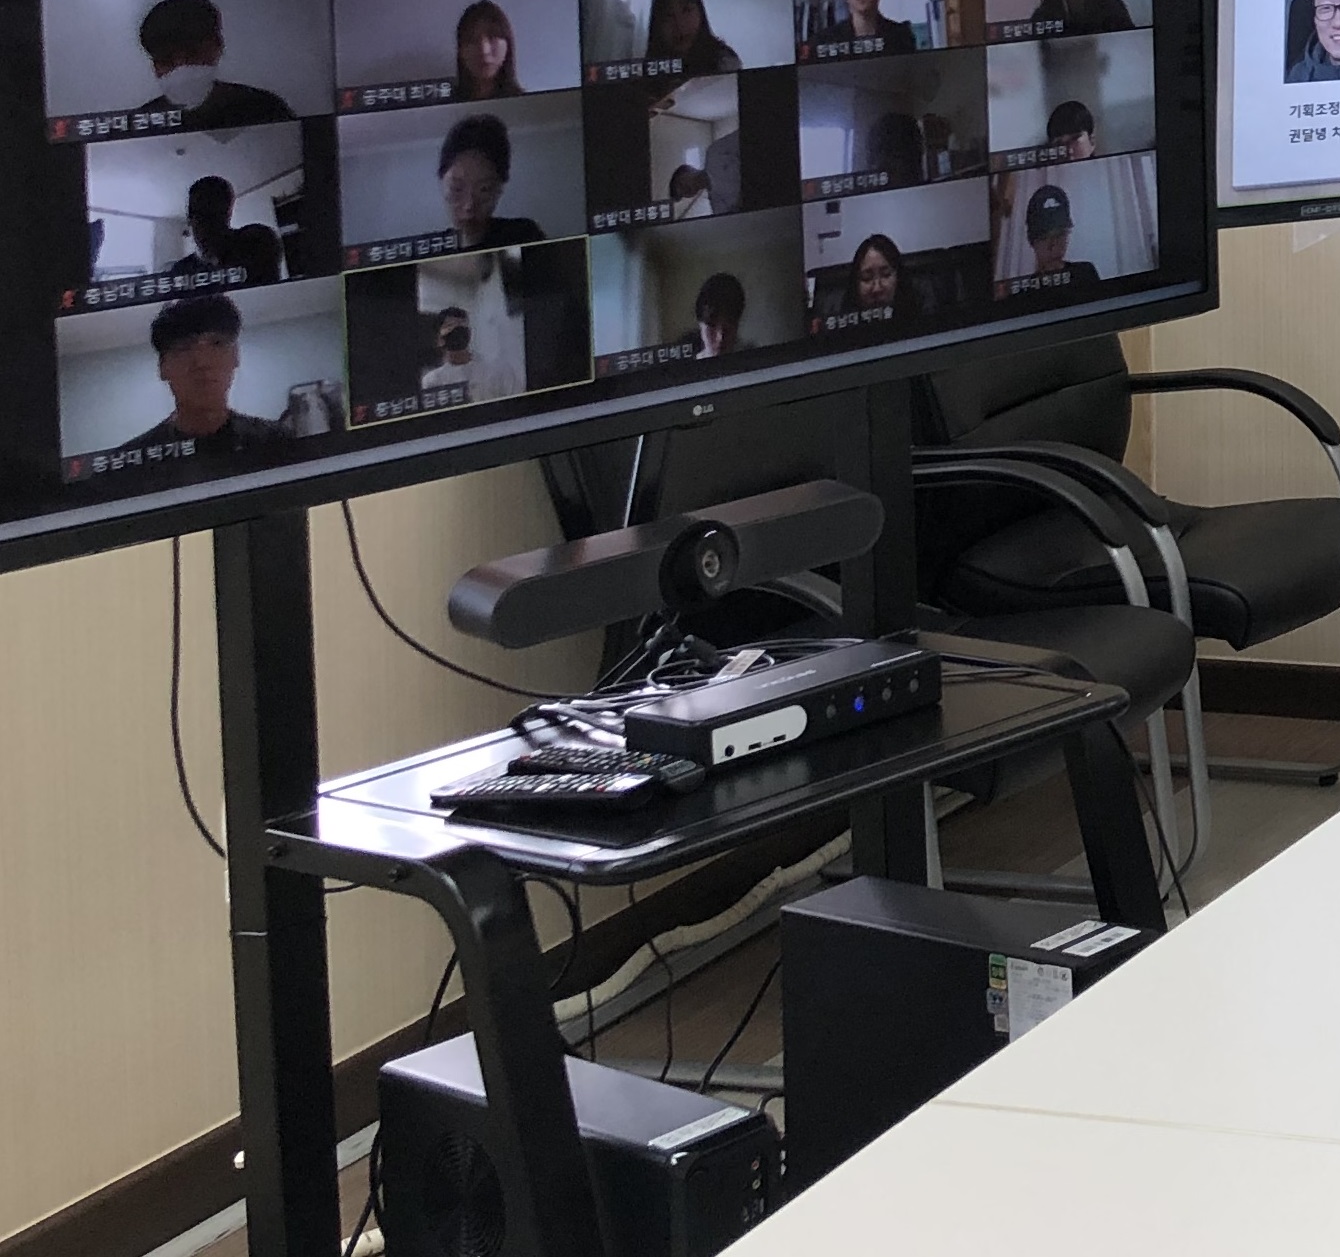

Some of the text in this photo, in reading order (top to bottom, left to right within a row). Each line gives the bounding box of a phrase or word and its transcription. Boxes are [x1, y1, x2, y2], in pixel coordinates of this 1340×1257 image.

[362, 86, 407, 106] 공주대
[76, 114, 128, 136] 충남대
[369, 242, 414, 263] 충남대
[85, 283, 136, 305] 충남대
[617, 350, 654, 370] 공주대
[375, 396, 419, 418] 충남대
[92, 448, 143, 473] 충남대
